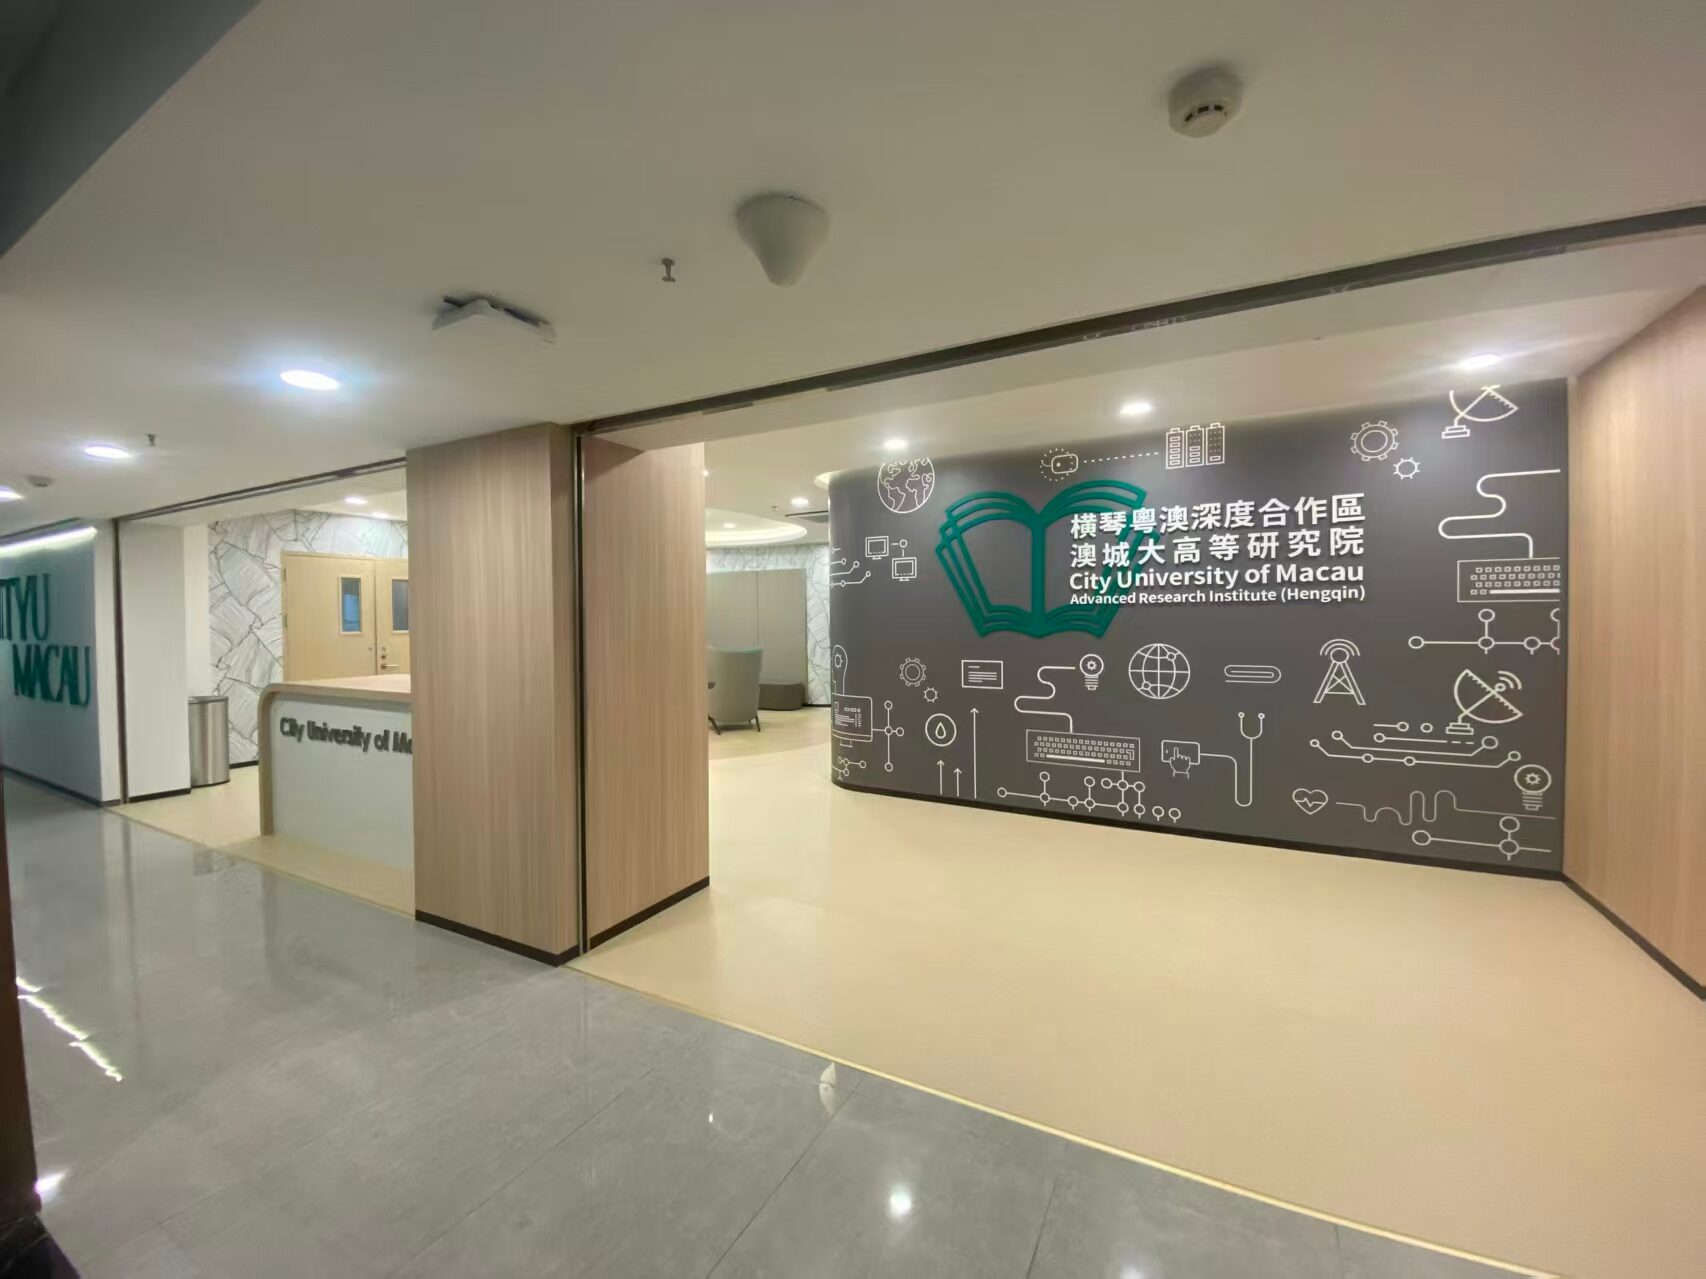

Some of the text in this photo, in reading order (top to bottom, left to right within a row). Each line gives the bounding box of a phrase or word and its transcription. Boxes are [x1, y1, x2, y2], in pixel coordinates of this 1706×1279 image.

[1070, 525, 1365, 569] 澳城大高等研究院
[1069, 562, 1365, 595] City University of Macau
[1069, 585, 1367, 606] Advanced Research Institute (Hengqin)
[12, 643, 91, 706] MACAU
[280, 716, 304, 742] City
[307, 719, 371, 752] University
[373, 729, 389, 751] of
